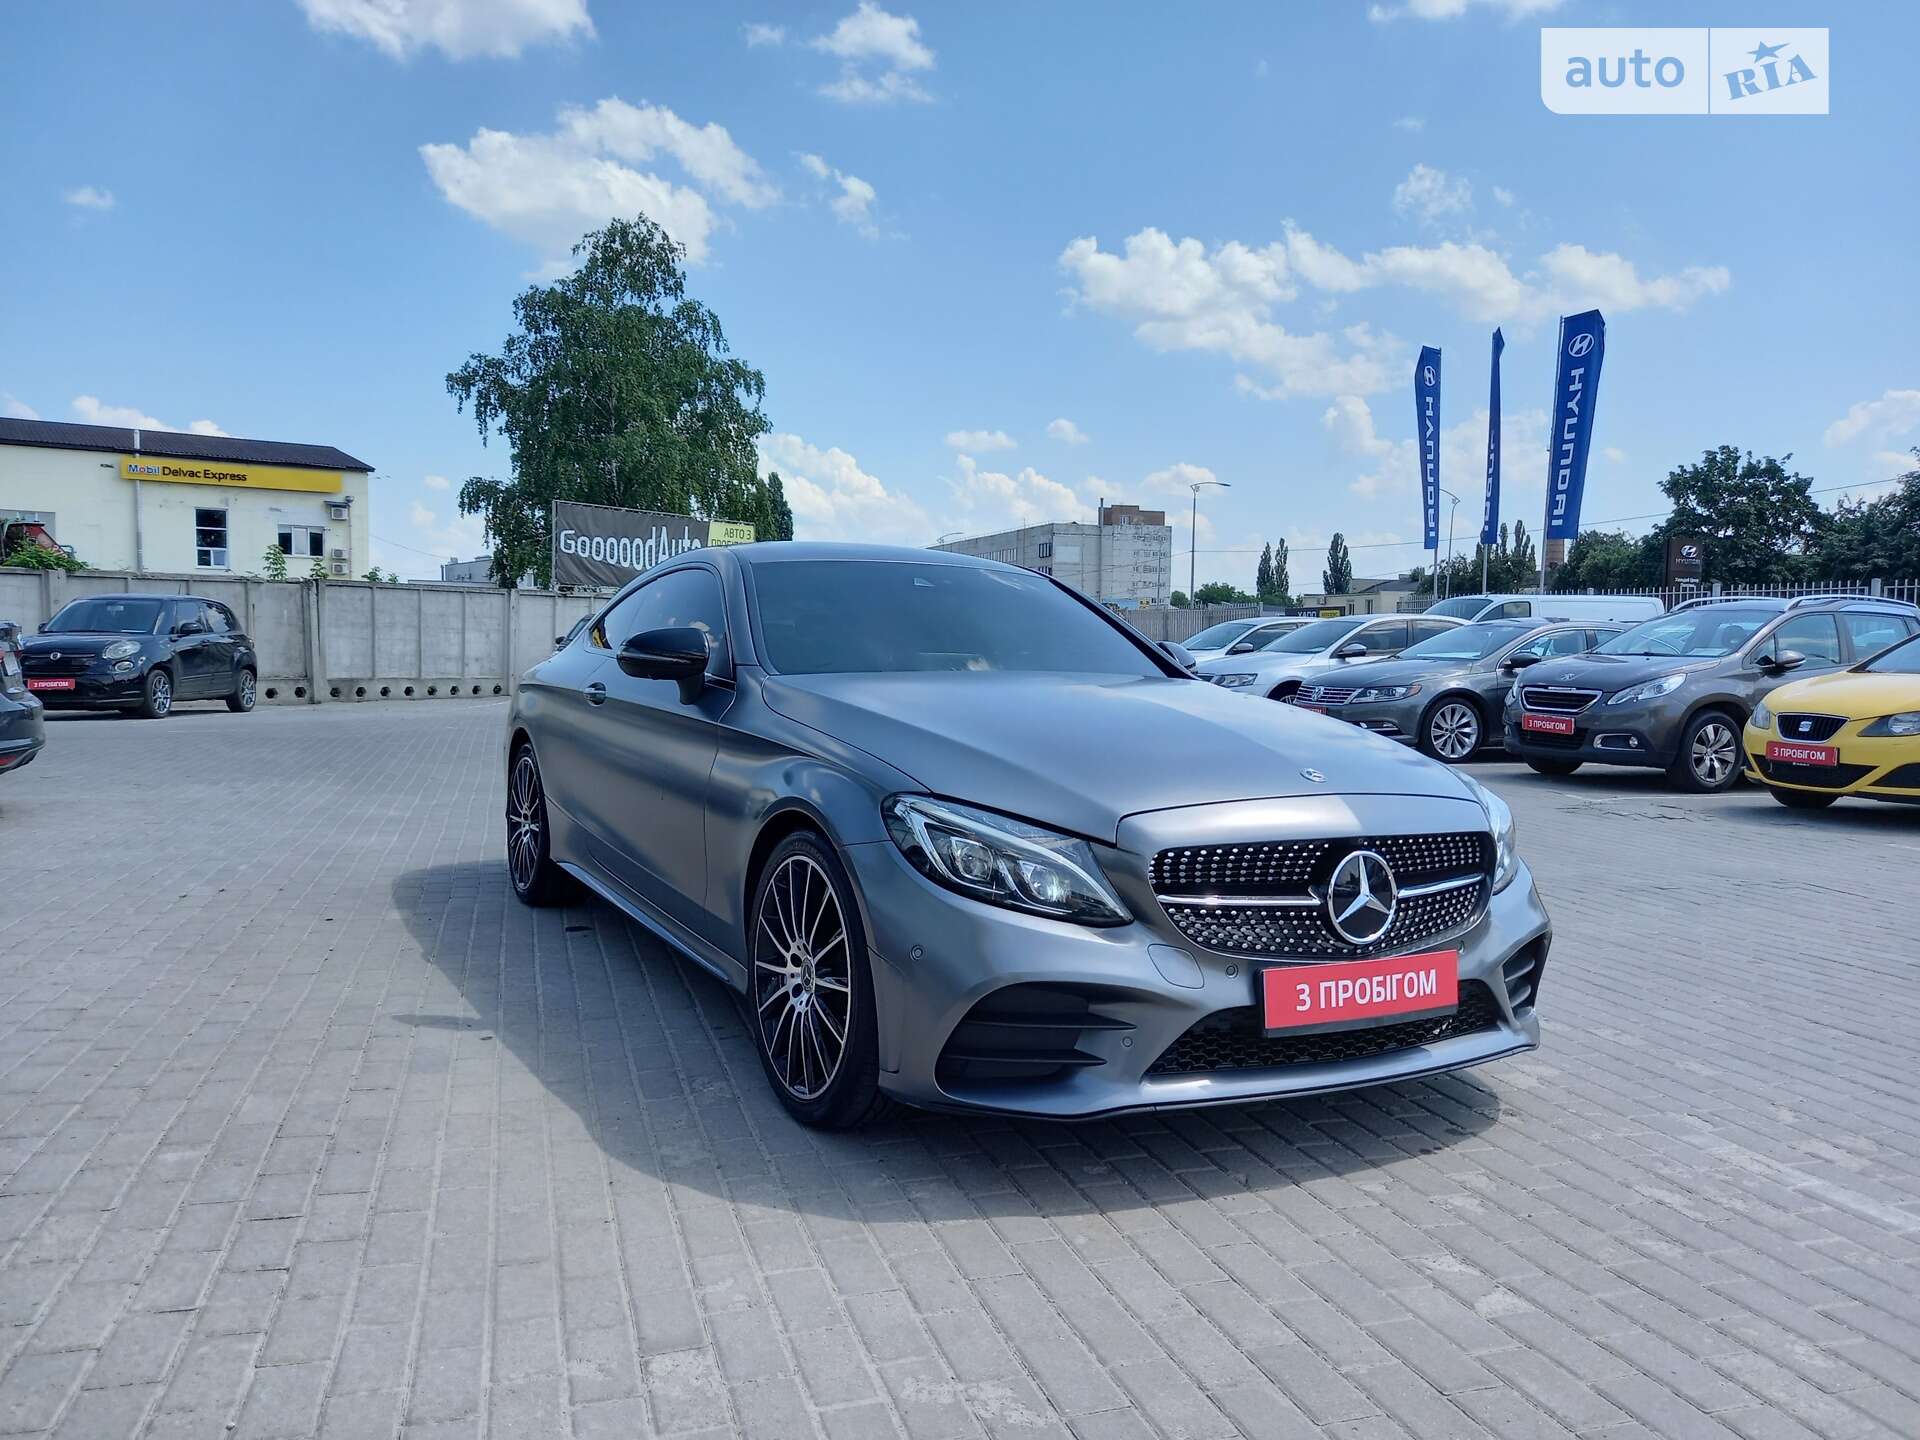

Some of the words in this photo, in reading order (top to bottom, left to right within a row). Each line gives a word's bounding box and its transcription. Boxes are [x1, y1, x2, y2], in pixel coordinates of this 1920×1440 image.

[1551, 367, 1585, 526] HYUNDAI
[128, 464, 160, 476] Mobil
[162, 466, 201, 479] Delvac
[203, 469, 248, 482] Express
[1780, 748, 1826, 761] ПРОБІГОМ
[1295, 983, 1312, 1012] З
[1319, 968, 1437, 1009] ПРОБІГОМ
